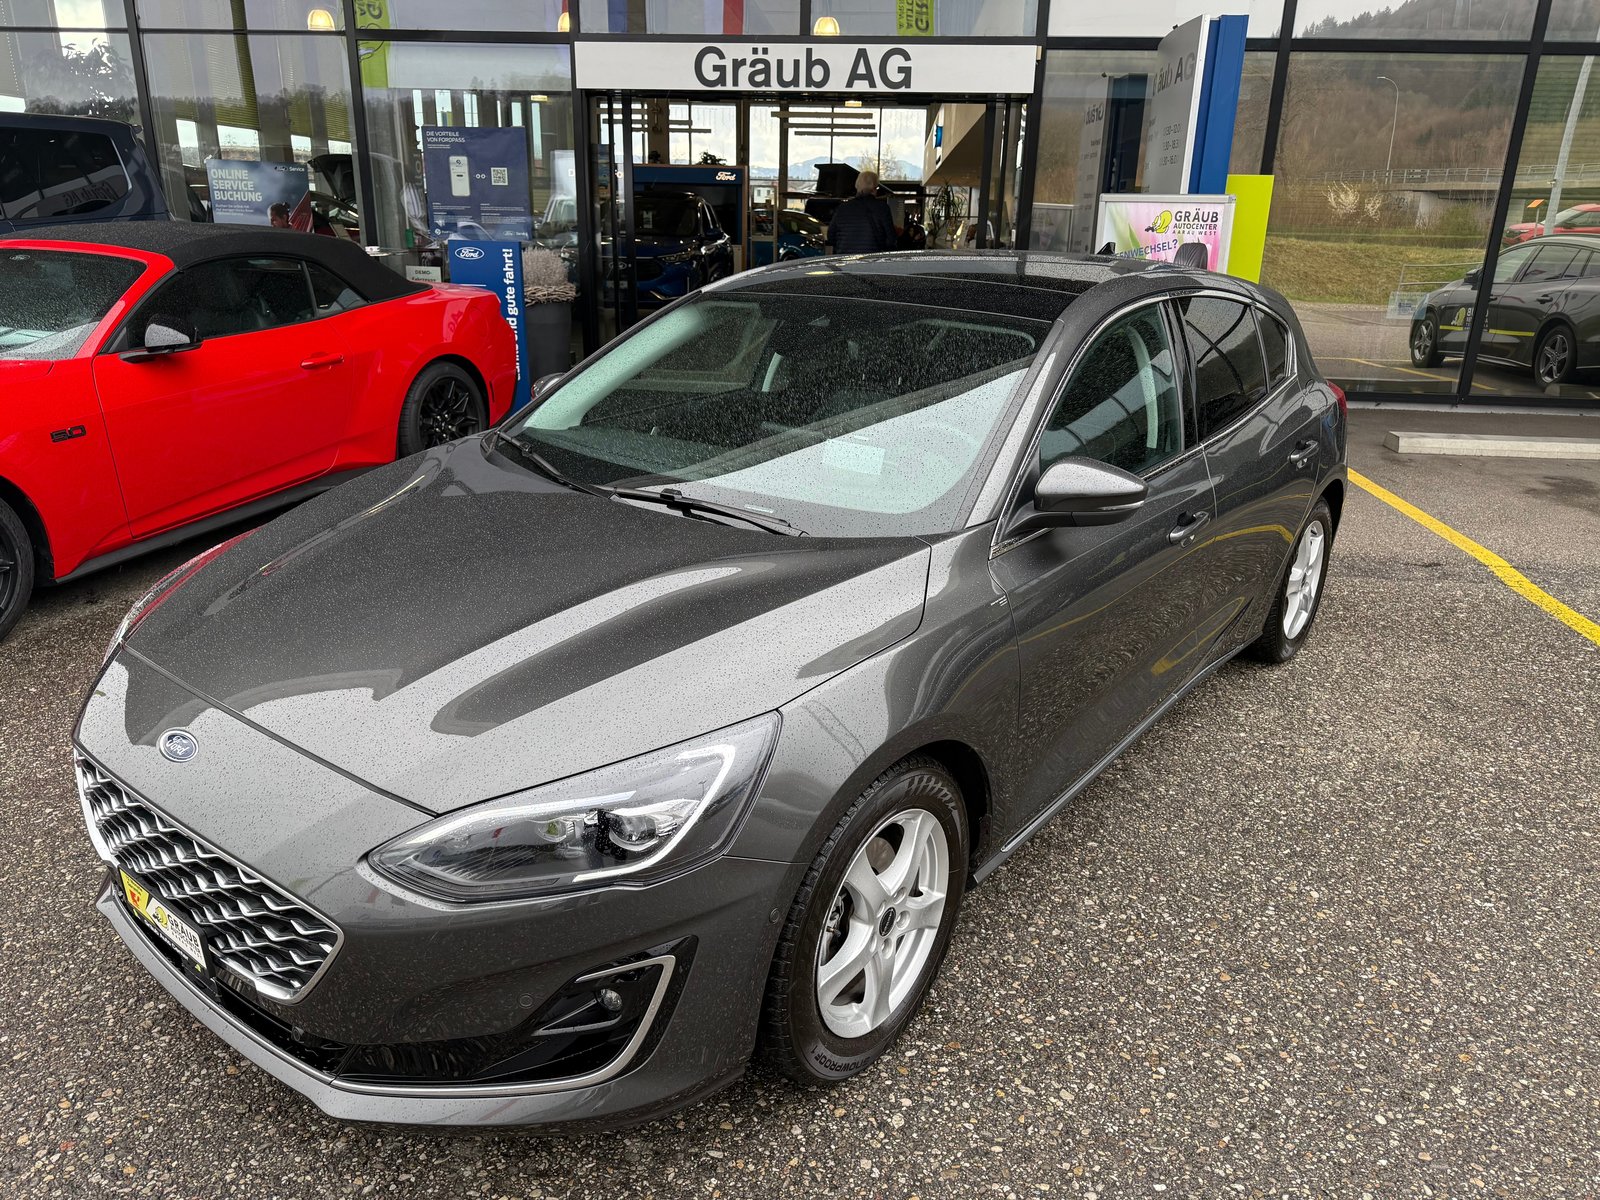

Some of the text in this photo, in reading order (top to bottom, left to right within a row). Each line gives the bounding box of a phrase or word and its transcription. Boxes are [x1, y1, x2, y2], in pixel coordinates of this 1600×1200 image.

[694, 46, 912, 90] Gräub AG
[211, 169, 249, 179] ONLINE
[716, 171, 737, 181] Ford
[213, 180, 255, 191] SERVICE
[214, 191, 263, 202] BUCHUNG
[1174, 207, 1219, 223] GRÄUB
[1173, 222, 1218, 231] AUTOCENTER
[458, 248, 481, 259] Ford
[502, 248, 515, 286] fahrt!
[504, 287, 519, 316] gute
[164, 734, 192, 757] Ford
